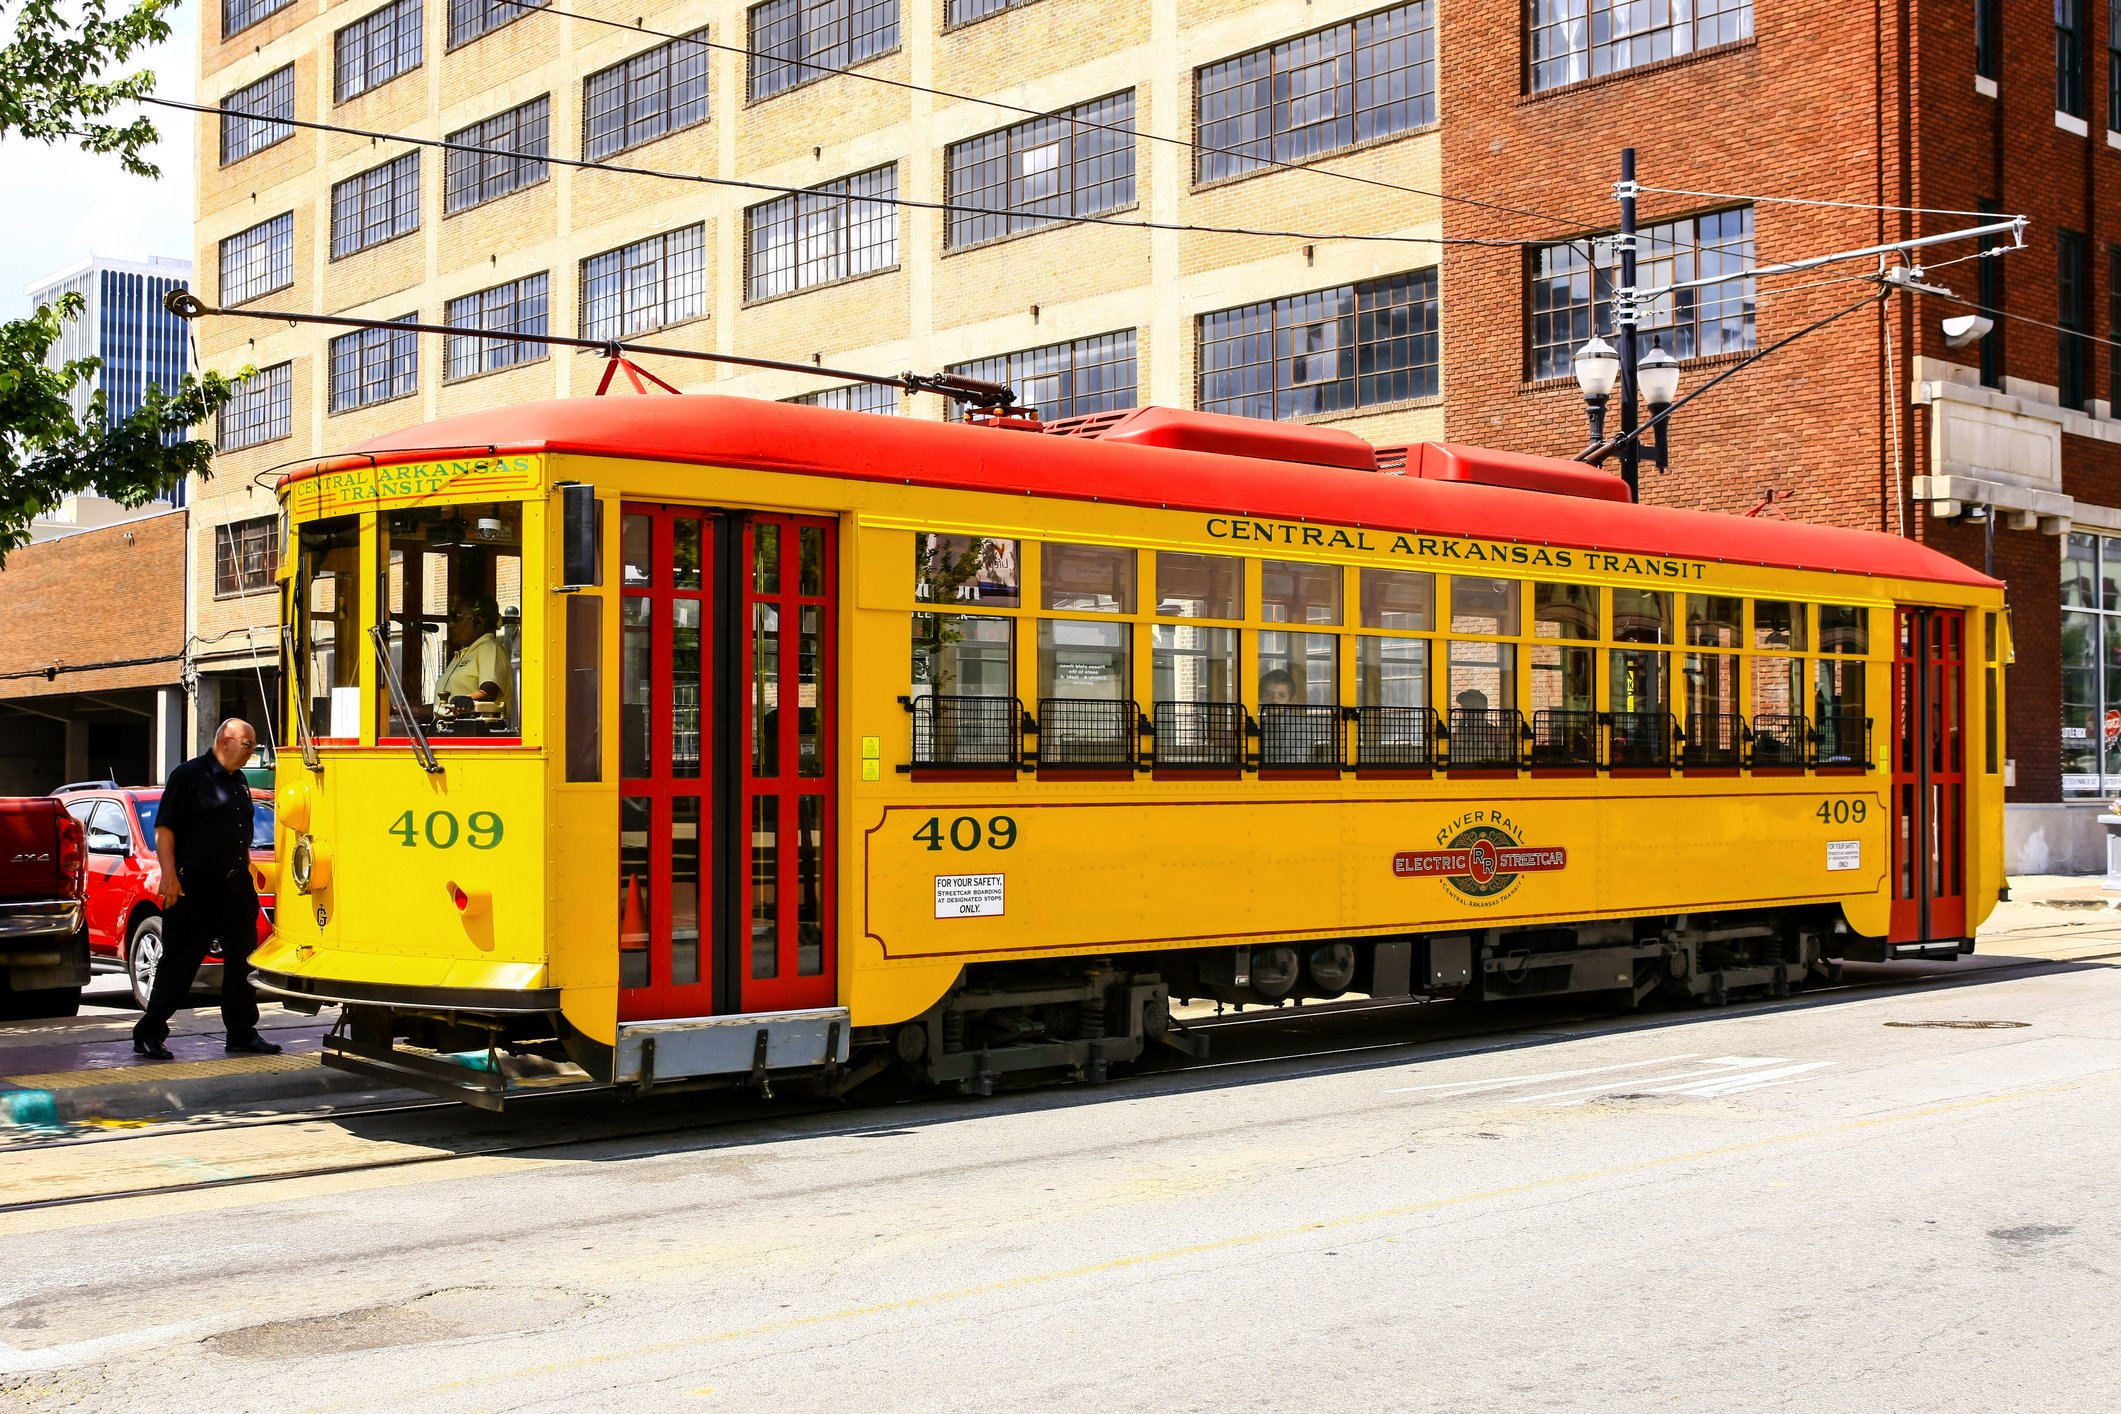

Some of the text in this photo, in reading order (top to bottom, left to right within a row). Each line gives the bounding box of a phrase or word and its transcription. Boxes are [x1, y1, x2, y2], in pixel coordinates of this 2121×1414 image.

[298, 457, 530, 495] CENTRAL ARKANSAS
[340, 479, 442, 501] TRANSIT
[1206, 518, 1707, 580] CENTRAL ARKANSAS TRANSIT
[1816, 800, 1866, 823] 409
[388, 810, 504, 849] 409
[913, 816, 1017, 851] 409
[1436, 810, 1524, 845] RIVER RAIL
[1396, 856, 1465, 871] ELECTRIC
[1500, 852, 1563, 866] STREETCAR
[937, 878, 952, 888] FOR
[953, 877, 972, 887] YOUR
[1442, 881, 1522, 908] CENTRAL ARKANSAS TRANSIT
[959, 904, 981, 914] ONLY.
